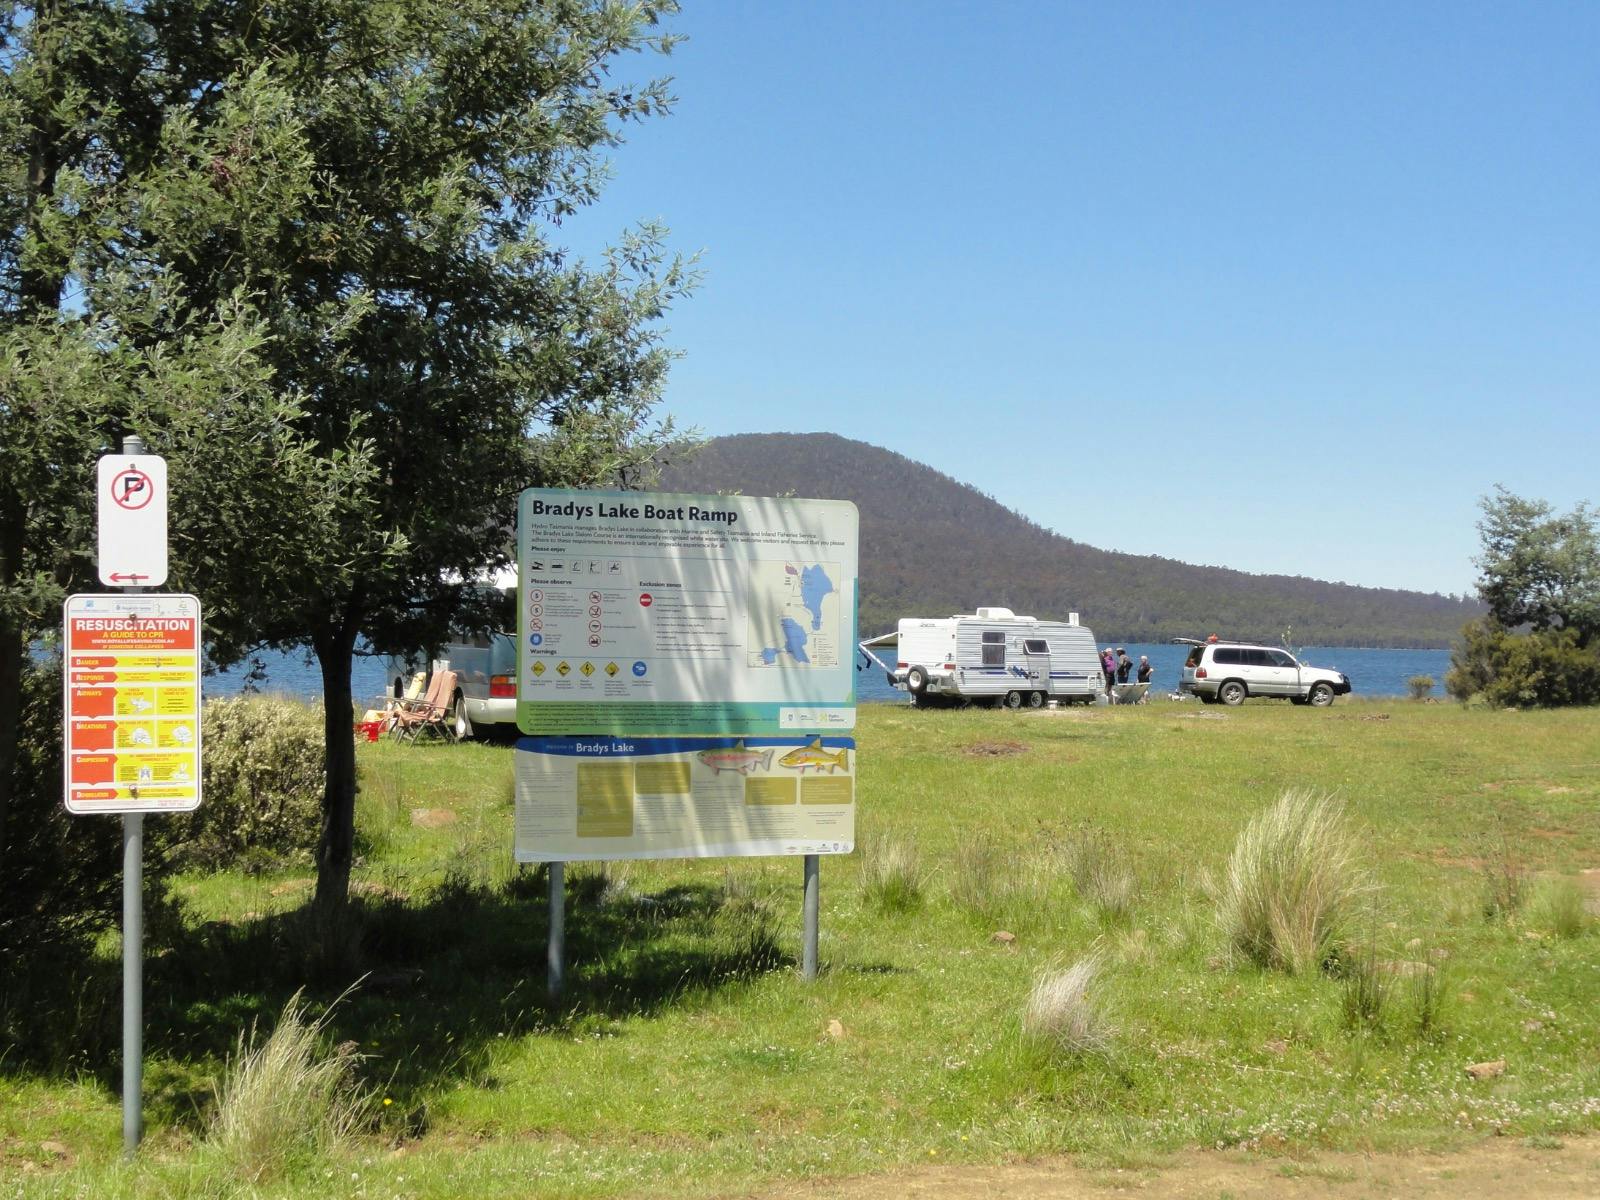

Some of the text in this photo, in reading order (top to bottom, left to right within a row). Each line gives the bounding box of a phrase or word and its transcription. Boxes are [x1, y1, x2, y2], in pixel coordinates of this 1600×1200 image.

[533, 500, 738, 525] Bradys Lake Boat Ramp
[576, 742, 609, 755] Bradys
[612, 742, 634, 752] Lake
